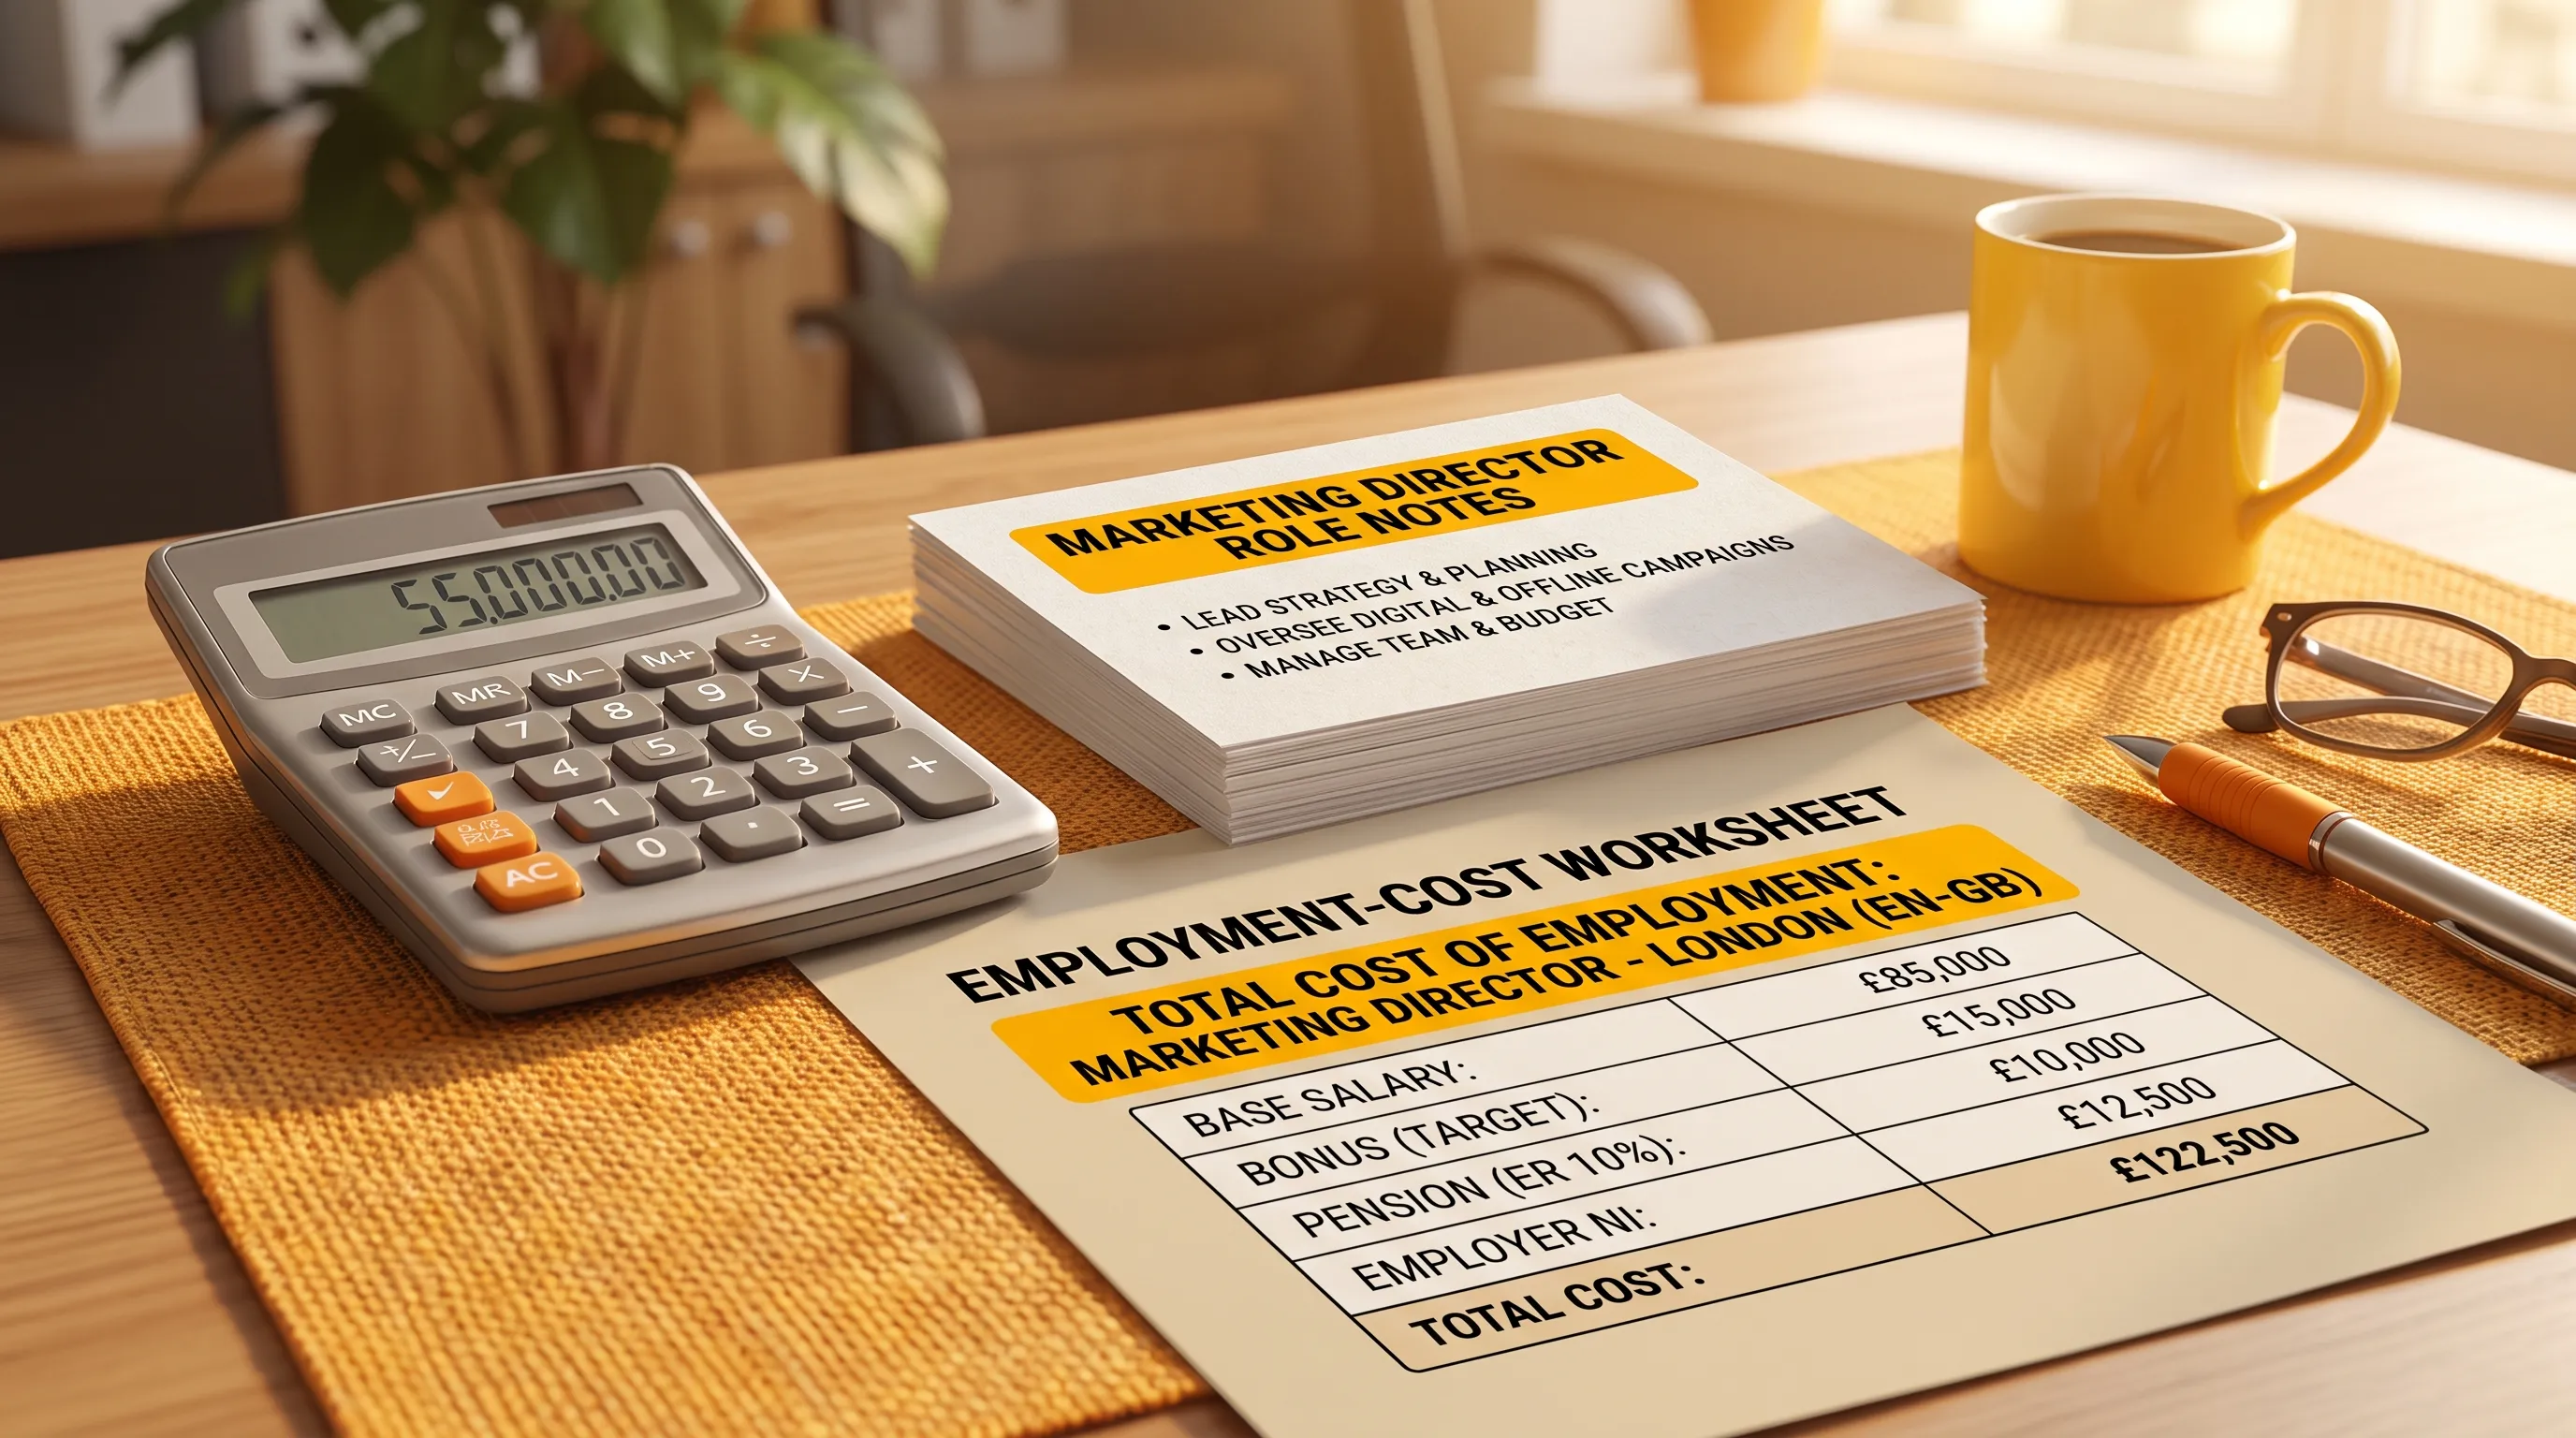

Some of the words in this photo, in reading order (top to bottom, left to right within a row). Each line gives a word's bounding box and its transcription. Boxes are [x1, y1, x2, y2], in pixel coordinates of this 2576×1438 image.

[1046, 487, 1361, 556] MARKETING
[1358, 440, 1623, 500] DIRECTOR
[1214, 518, 1362, 559] ROLE
[1356, 488, 1535, 534] NOTES
[1180, 604, 1262, 631] LEAD
[1264, 575, 1413, 620] STRATEGY
[1418, 570, 1447, 587] &
[1442, 542, 1598, 582] PLANNING
[1215, 616, 1354, 653] OVERSEE
[1350, 596, 1472, 638] DIGITAL
[1470, 591, 1499, 607] &
[1497, 566, 1623, 601] OFFLINE
[1620, 535, 1794, 579] CAMPAIGNS
[641, 648, 695, 668] M+
[1243, 640, 1383, 679] MANAGE
[1377, 624, 1470, 653] TEAM
[1471, 621, 1500, 637] &
[1495, 596, 1614, 632] BUDGET
[339, 705, 397, 726] MC
[452, 683, 511, 705] MR
[604, 702, 634, 720] 8
[697, 683, 726, 702] 9
[505, 720, 527, 740] 7
[646, 737, 676, 756] 5
[743, 719, 772, 738] 6
[553, 757, 579, 777] 4
[691, 776, 726, 798] 2
[787, 756, 819, 775] 3
[593, 798, 621, 816] 1
[637, 837, 666, 858] 0
[506, 862, 558, 888] AC
[946, 858, 1543, 1003] EMPLOYMENT-COST
[1539, 786, 1906, 881] WORKSHEET
[1109, 982, 1295, 1034] TOTAL
[1295, 948, 1438, 997] COST
[1445, 932, 1514, 967] OF
[1518, 858, 1899, 952] EMPLOYMENT:
[1070, 1006, 1370, 1085] MARKETING
[1368, 957, 1621, 1023] DIRECTOR
[1647, 907, 1853, 966] LONDON
[1852, 868, 2042, 931] (EN-GB)
[1859, 947, 2010, 994] £85,000
[1923, 990, 2076, 1037] £15,000
[1990, 1033, 2144, 1082] £10,000
[1183, 1095, 1303, 1137] BASE
[1301, 1061, 1477, 1111] SALARY:
[2058, 1078, 2216, 1129] £12,500
[1237, 1137, 1389, 1185] BONUS
[1394, 1093, 1599, 1157] (TARGET):
[2110, 1123, 2299, 1183] £122,500
[1293, 1177, 1490, 1238] PENSION
[1493, 1160, 1571, 1199] (ER
[1568, 1136, 1686, 1175] 10%):
[1352, 1220, 1592, 1291] EMPLOYER
[1587, 1207, 1657, 1236] NI:
[1409, 1294, 1566, 1345] TOTAL
[1564, 1263, 1705, 1310] COST:
